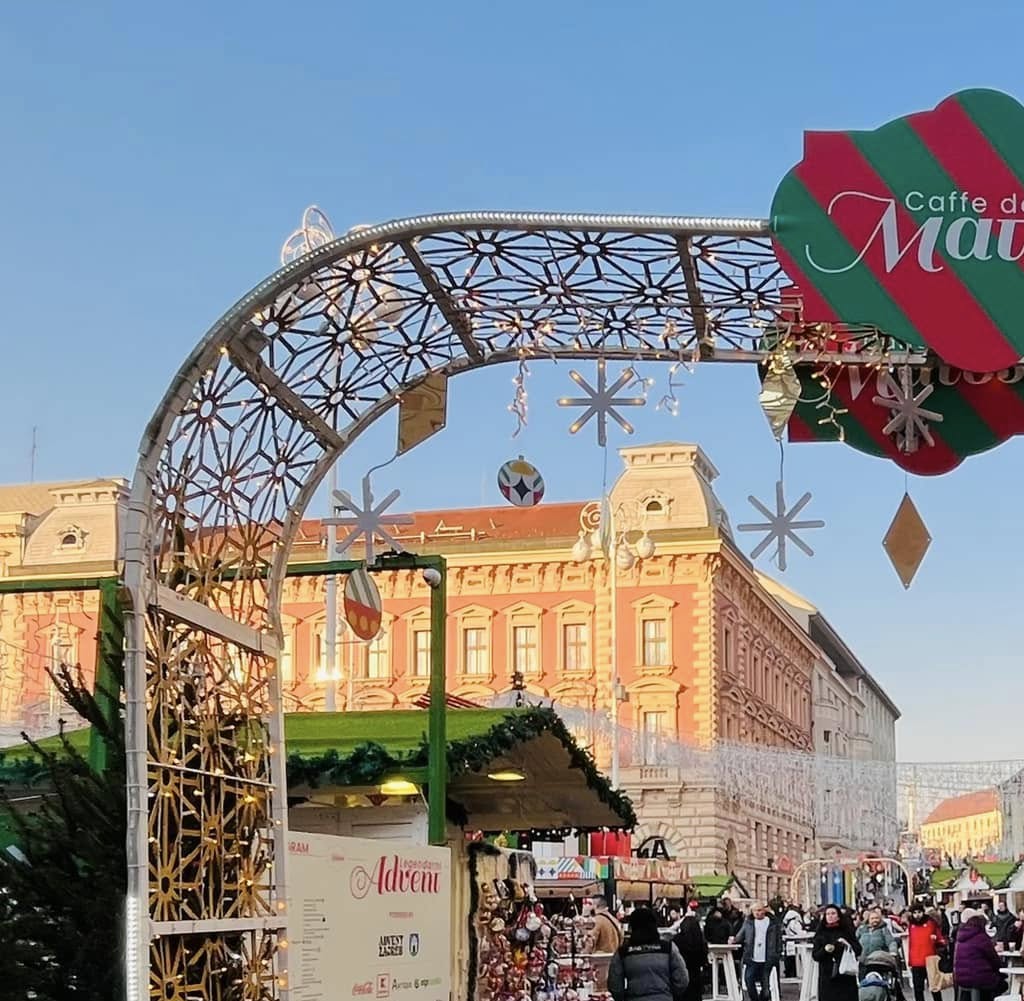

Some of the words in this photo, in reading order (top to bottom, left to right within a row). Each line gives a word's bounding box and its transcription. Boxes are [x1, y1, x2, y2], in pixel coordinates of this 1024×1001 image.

[905, 190, 987, 215] Caffe
[287, 841, 310, 854] RAM
[351, 855, 442, 899] Advent
